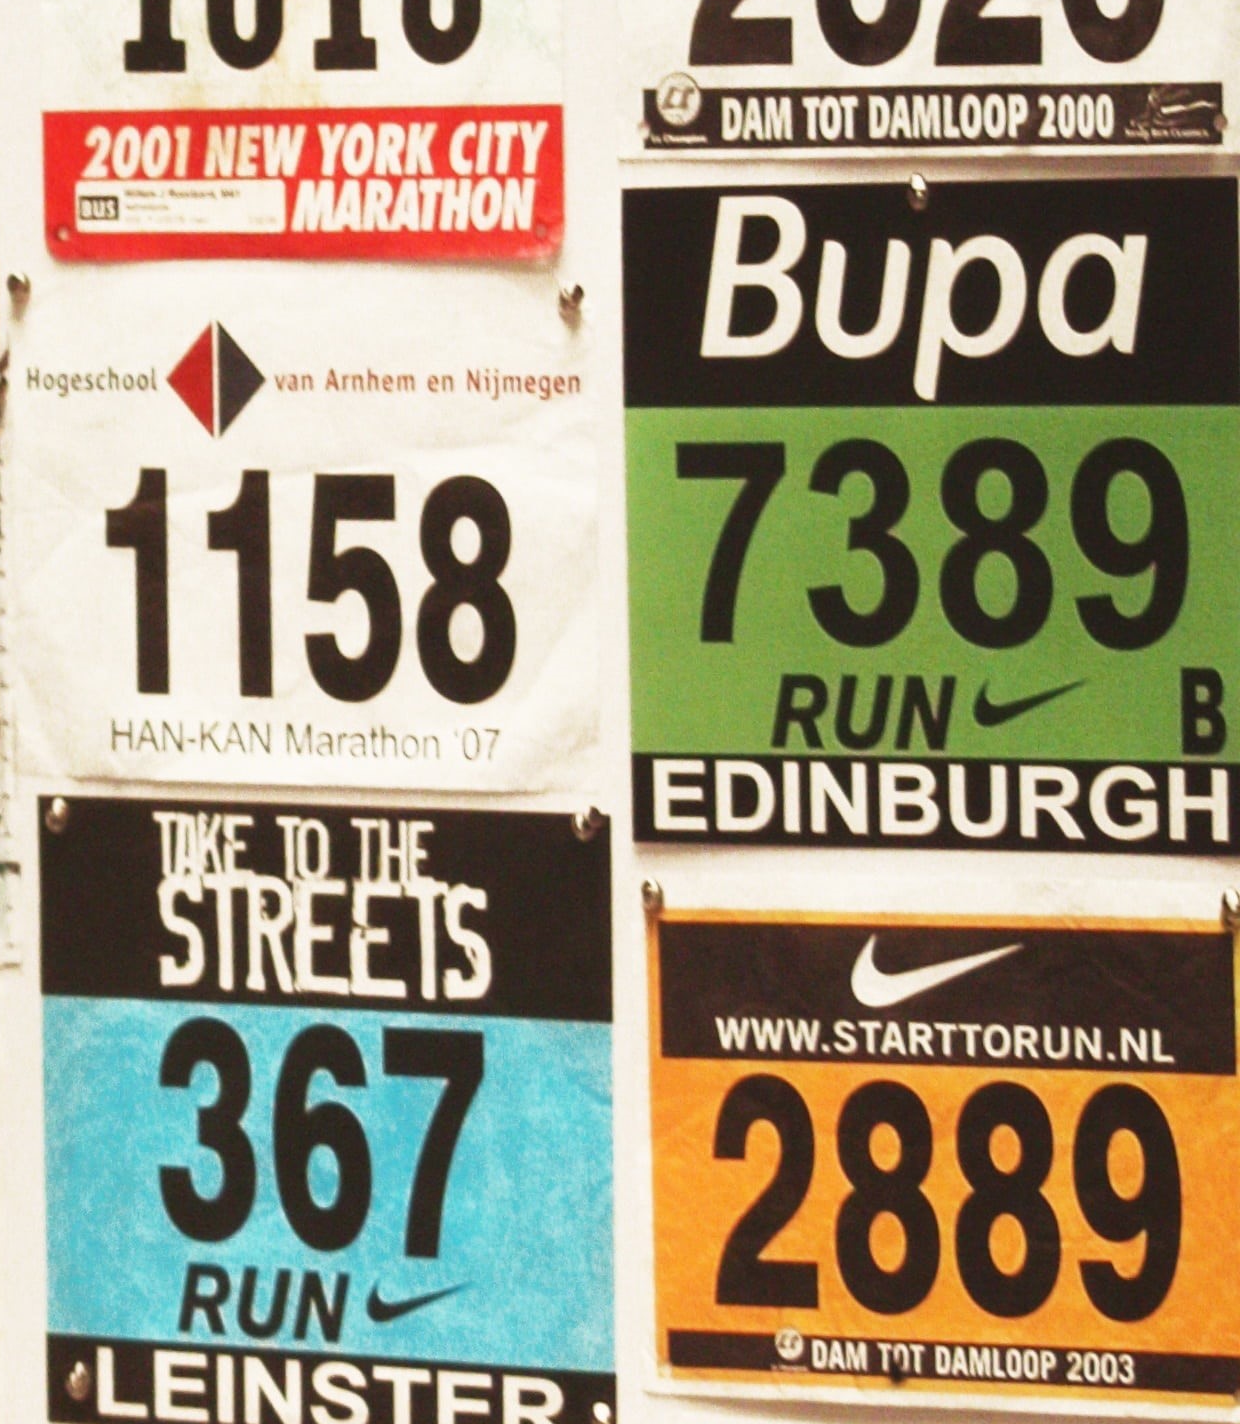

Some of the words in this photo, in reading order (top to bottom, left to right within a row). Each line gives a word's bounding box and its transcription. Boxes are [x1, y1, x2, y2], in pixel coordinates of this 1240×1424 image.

[81, 125, 191, 179] 2001
[204, 124, 307, 178] NEW
[317, 122, 442, 177] YORK
[449, 120, 549, 175] CITY
[721, 95, 794, 143] DAM
[802, 95, 860, 140] TOT
[867, 94, 1029, 141] DAMLOOP
[1038, 93, 1115, 140] 2000
[291, 177, 535, 233] MARATHON
[700, 194, 1148, 402] Bupa
[26, 367, 158, 396] Hogeschool
[274, 372, 314, 393] van
[324, 369, 416, 394] Arnhem
[427, 373, 455, 393] en
[465, 369, 582, 402] Nijmegen
[675, 436, 1190, 652] 7389
[105, 466, 517, 706] 1158
[770, 672, 957, 752] RUN
[1179, 666, 1228, 756] B
[652, 758, 1231, 843] EDINBURGH
[153, 810, 254, 876] TAKE
[276, 815, 330, 879] TO
[350, 817, 435, 881] THE
[158, 876, 493, 1001] STREETS
[715, 1016, 1175, 1064] WWW.STARTTORUN.NL
[159, 1015, 485, 1260] 367
[712, 1072, 1183, 1324] 2889
[178, 1261, 350, 1343] RUN
